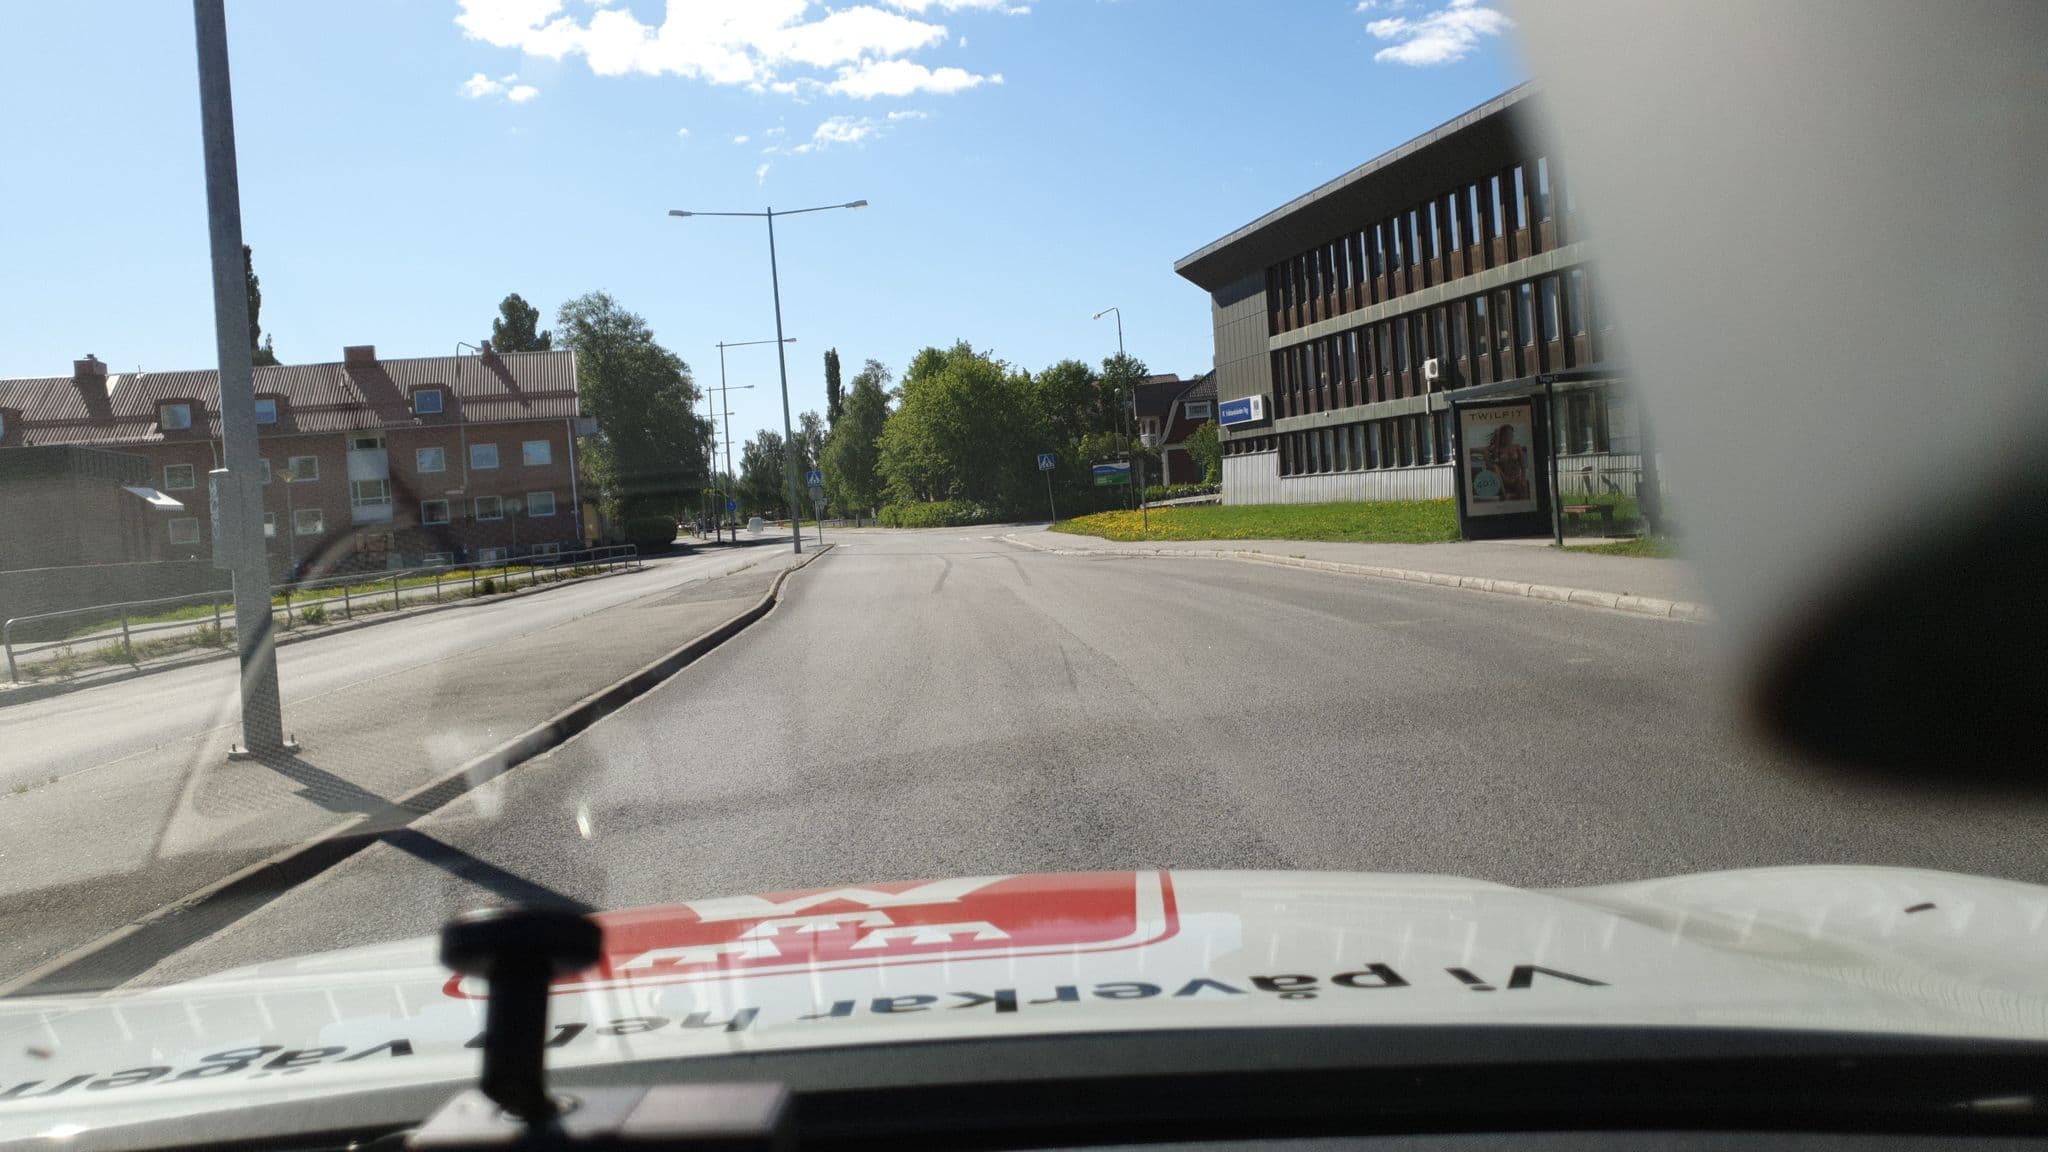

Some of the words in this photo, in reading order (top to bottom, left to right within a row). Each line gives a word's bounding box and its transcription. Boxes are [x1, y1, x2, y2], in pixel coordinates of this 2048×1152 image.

[1469, 410, 1522, 420] TWILFIT
[797, 963, 1411, 1020] påverkar
[1444, 964, 1612, 991] Vi
[464, 1006, 759, 1048] hel
